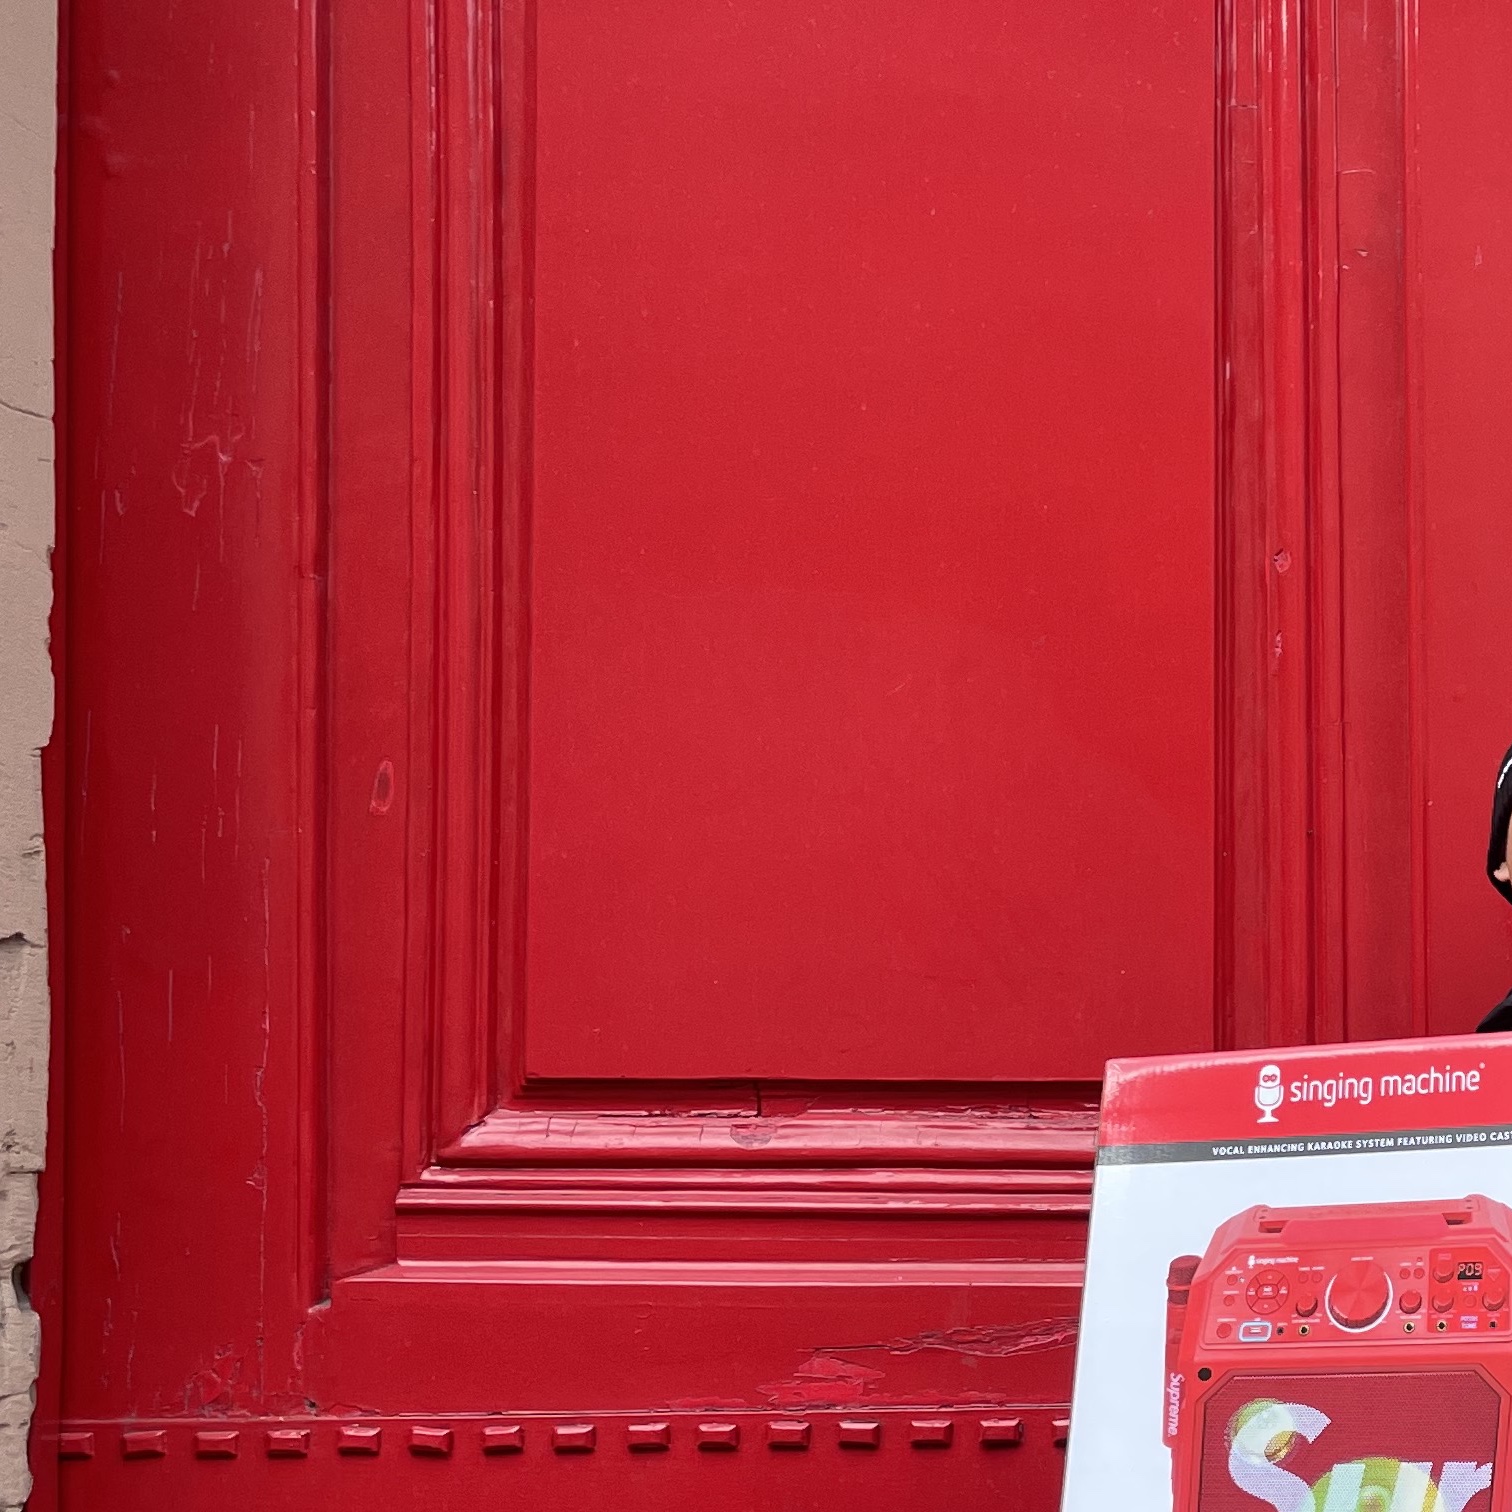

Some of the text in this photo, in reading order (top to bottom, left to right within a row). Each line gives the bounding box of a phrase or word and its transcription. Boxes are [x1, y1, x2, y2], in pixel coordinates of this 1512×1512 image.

[1290, 1065, 1480, 1108] singing machine
[1212, 1145, 1245, 1156] VOCAL
[1247, 1143, 1305, 1155] ENHANCING
[1307, 1140, 1354, 1152] KARAOKE
[1355, 1138, 1395, 1150] SYSTEM
[1397, 1134, 1453, 1147] FEATURING
[1455, 1132, 1487, 1144] VIDEO
[1166, 1372, 1186, 1437] Supreme
